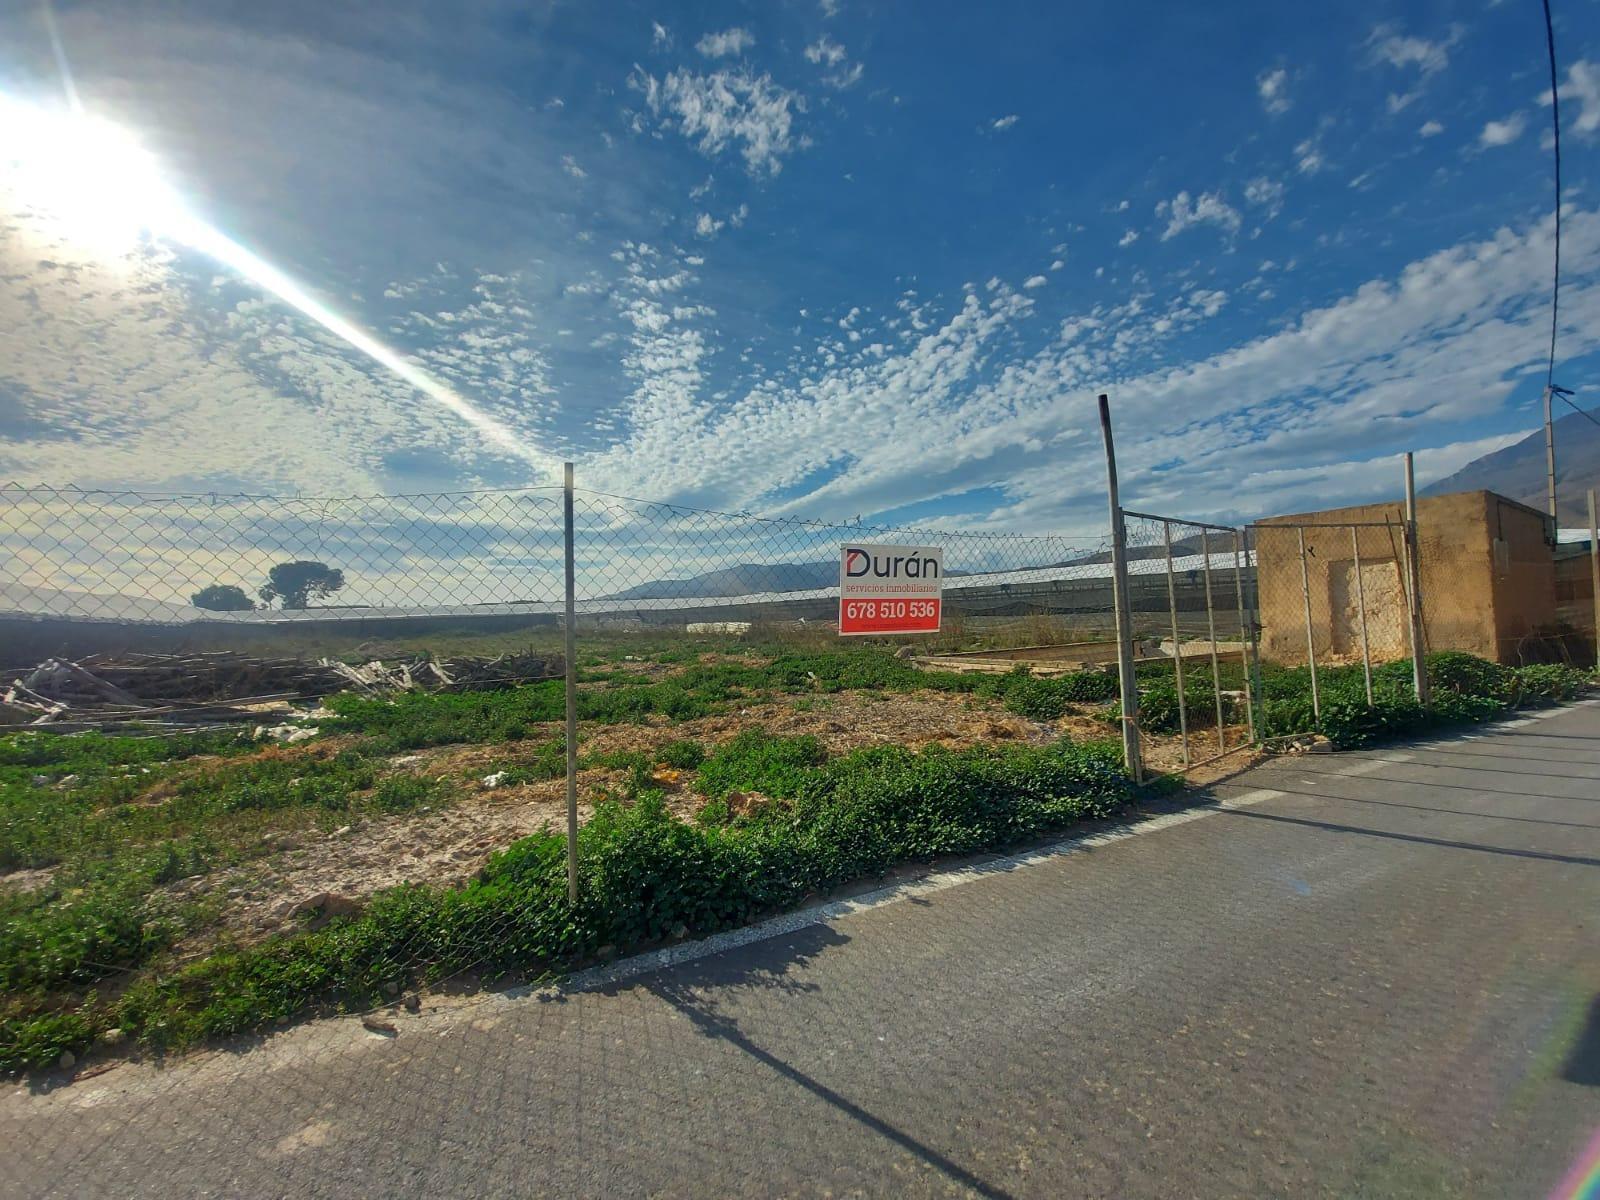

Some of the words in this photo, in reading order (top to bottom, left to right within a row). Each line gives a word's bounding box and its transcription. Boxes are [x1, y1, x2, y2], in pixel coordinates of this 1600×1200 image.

[847, 549, 938, 578] Durán
[846, 584, 884, 593] servicios
[886, 583, 937, 593] inmobiliarios
[847, 602, 876, 619] 678
[880, 602, 906, 618] 510
[909, 602, 935, 618] 536
